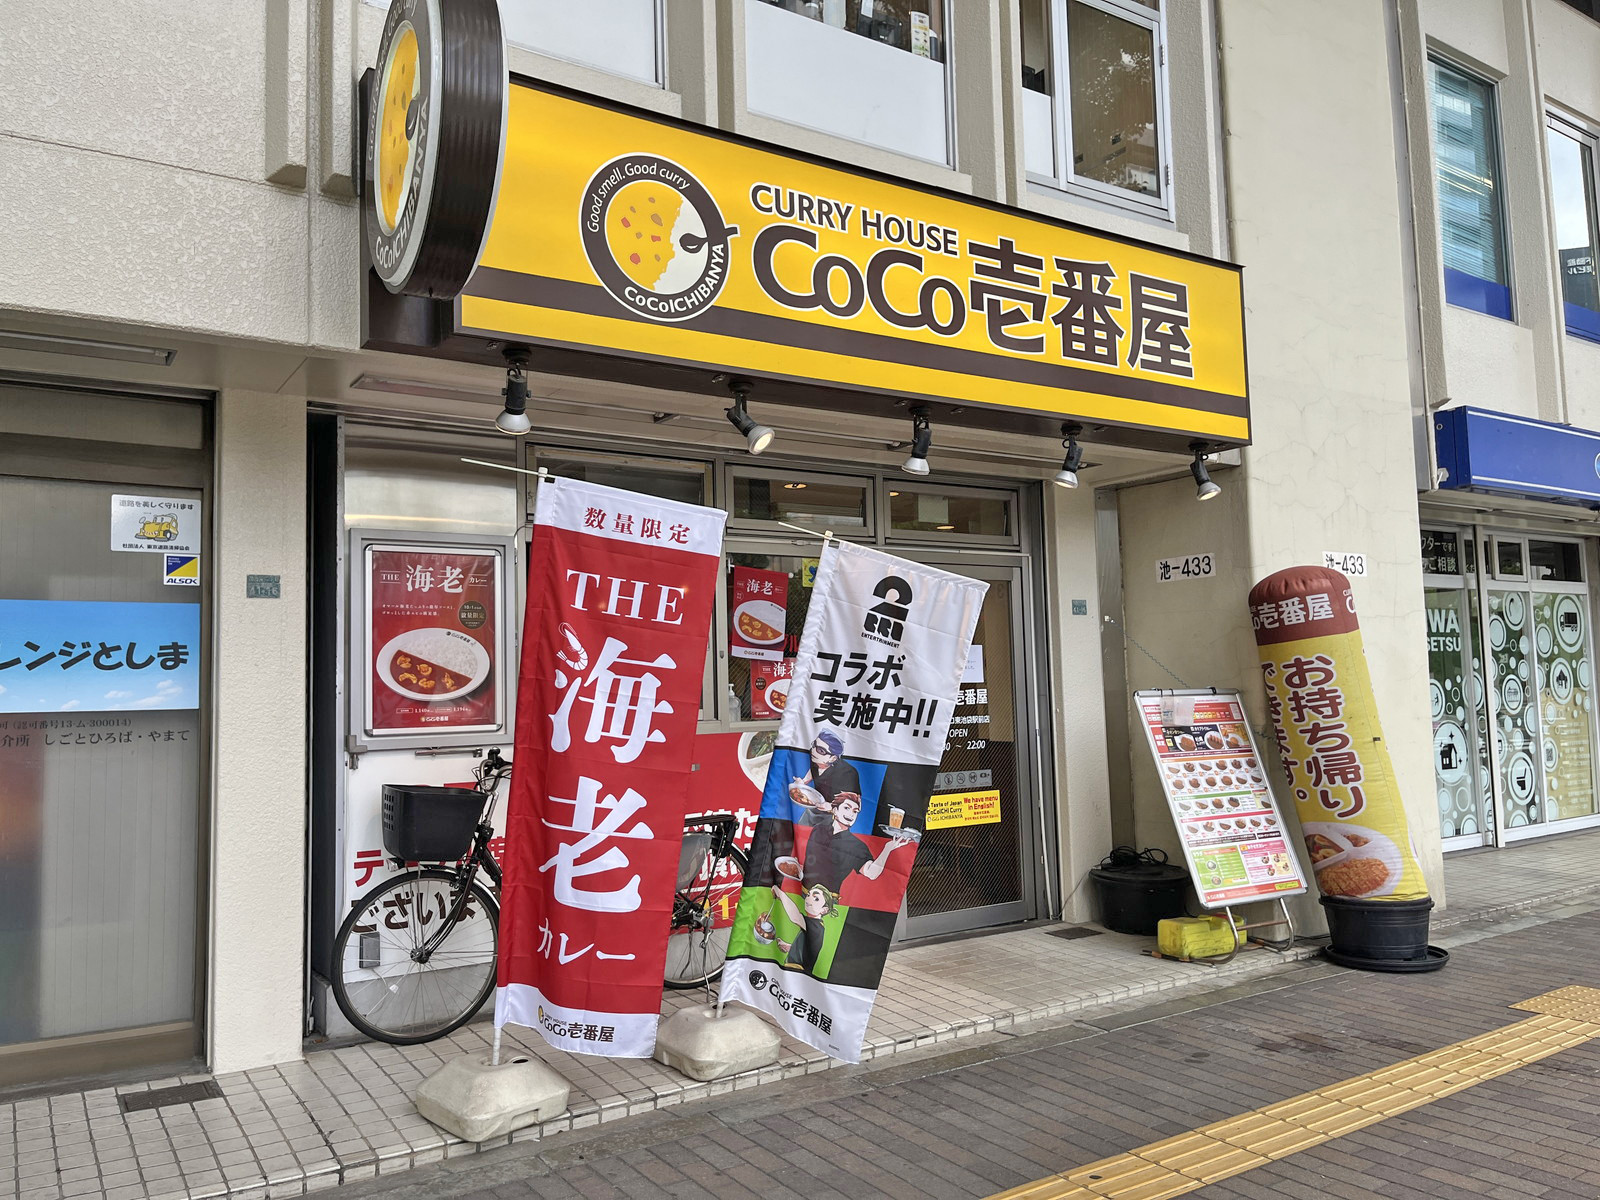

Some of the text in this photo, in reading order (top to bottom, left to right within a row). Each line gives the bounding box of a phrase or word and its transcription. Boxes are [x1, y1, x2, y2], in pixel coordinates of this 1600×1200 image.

[586, 162, 691, 233] Good smell. Good curry
[750, 182, 959, 257] CURRY HOUSE
[623, 243, 725, 314] CoCoICHIBANYA
[752, 223, 1194, 379] CoCo壱番屋
[584, 507, 691, 545] 数量限定
[166, 577, 198, 585] ALSOK
[381, 573, 400, 581] THE
[405, 564, 465, 594] 海老
[746, 579, 773, 596] 海老
[1159, 555, 1213, 581] 池-433
[566, 568, 686, 626] THE
[809, 651, 907, 691] コラボ
[949, 728, 968, 738] OPEN
[966, 740, 986, 750] 22:00
[1282, 655, 1365, 819] お持ち帰り
[538, 635, 678, 913] 海老
[536, 917, 636, 965] カレー
